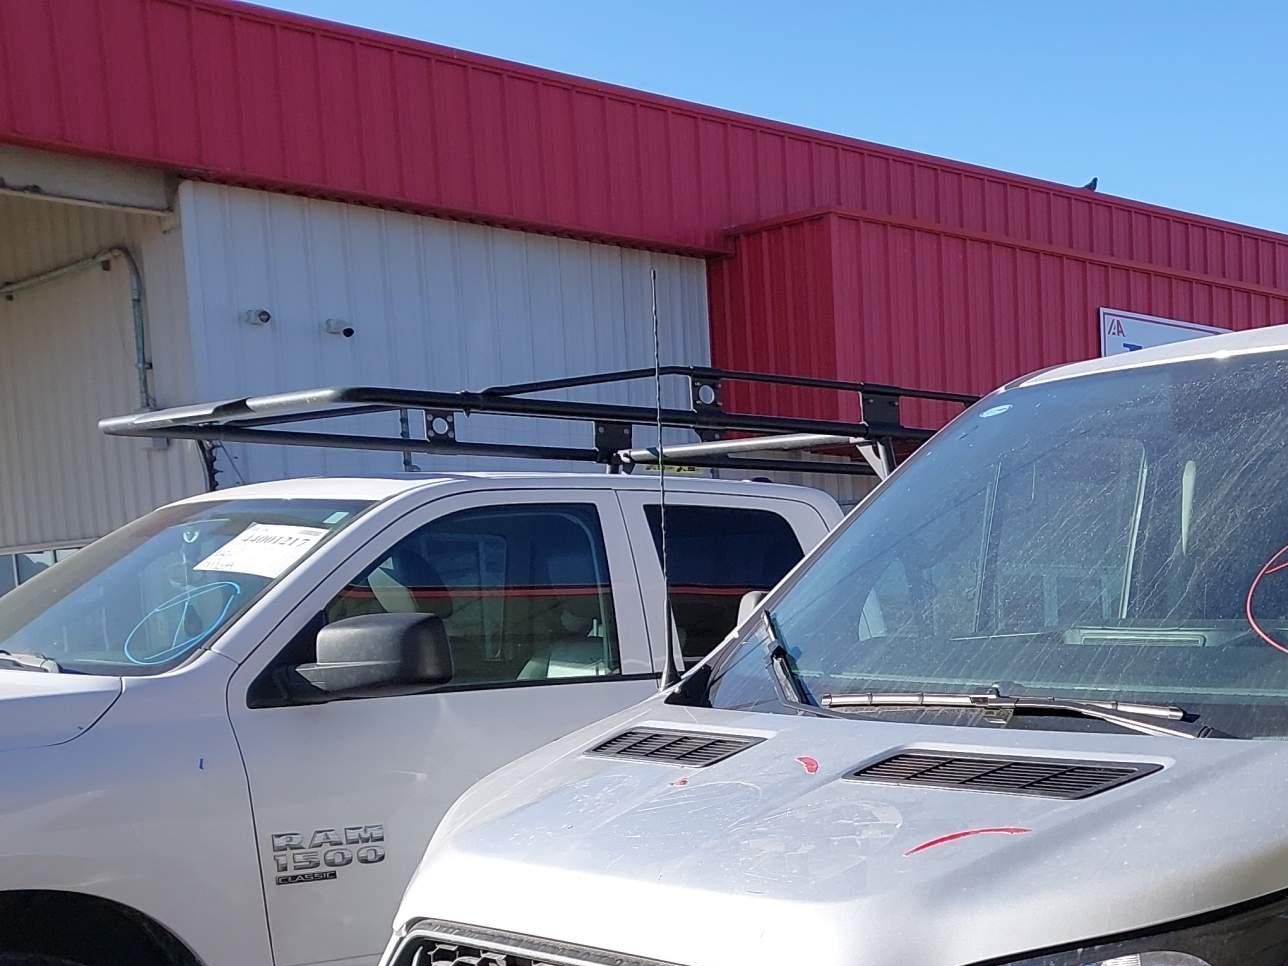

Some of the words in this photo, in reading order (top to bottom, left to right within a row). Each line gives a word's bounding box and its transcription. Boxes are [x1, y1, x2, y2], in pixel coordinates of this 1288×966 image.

[271, 824, 385, 852] RAM
[273, 845, 386, 872] 1500
[277, 871, 337, 885] CLASSIC
